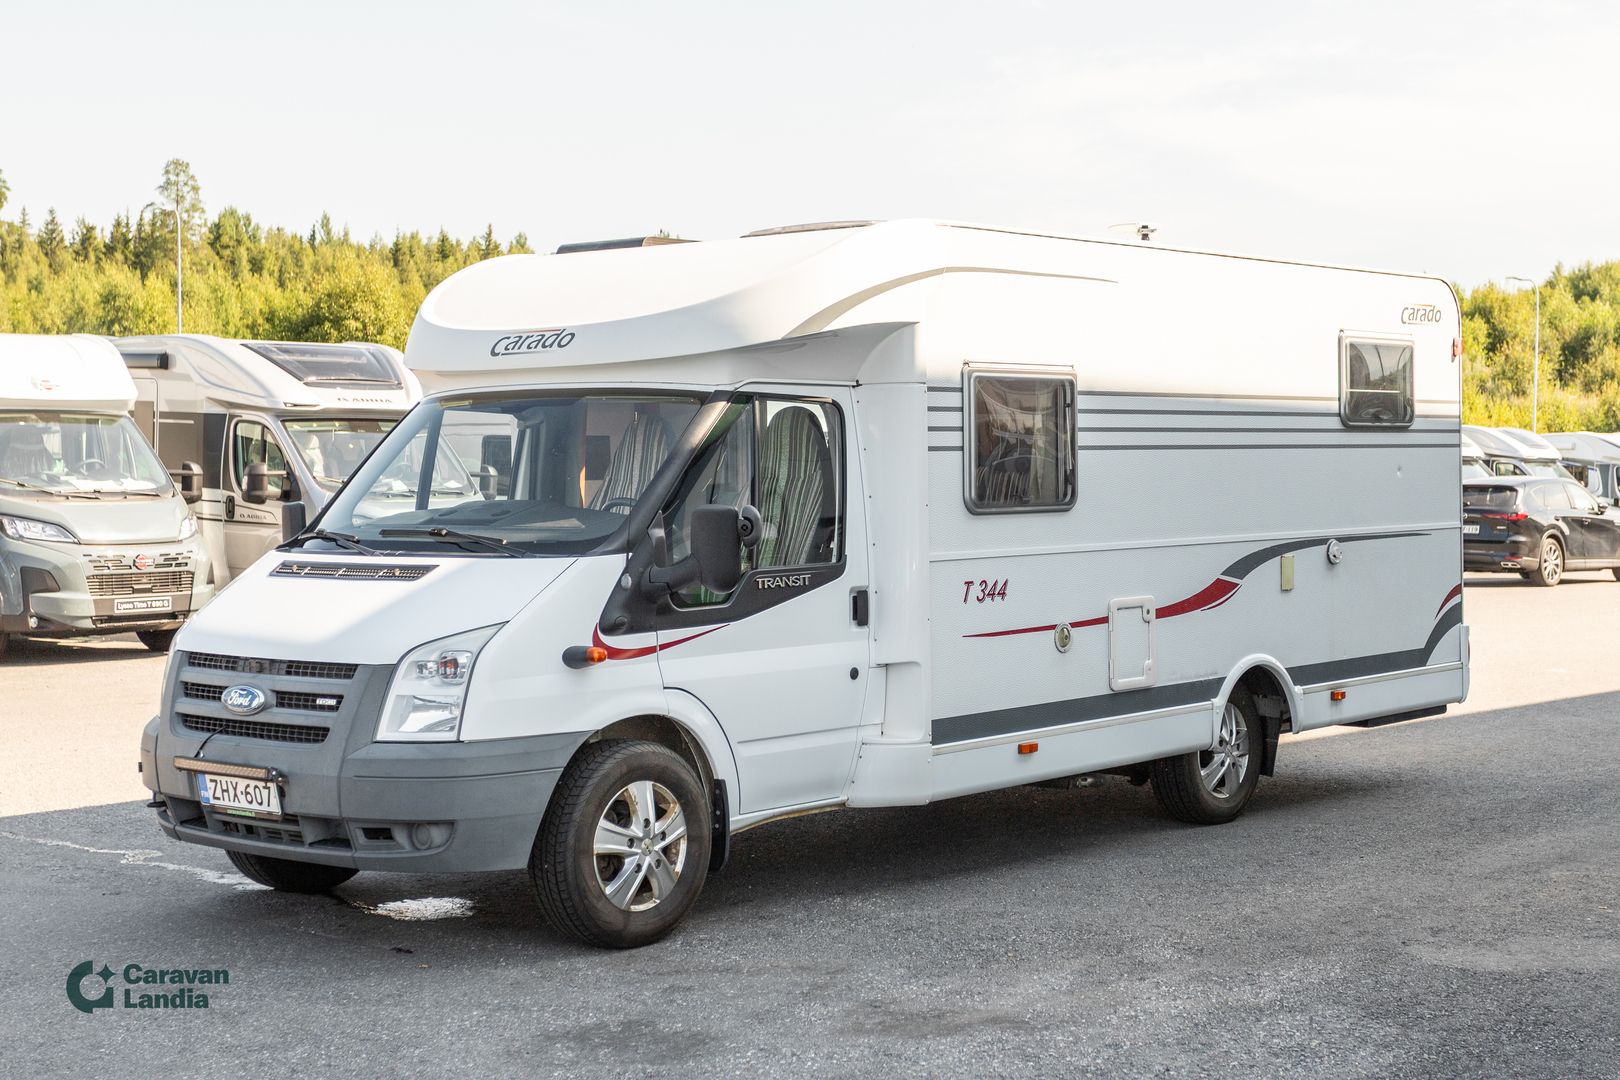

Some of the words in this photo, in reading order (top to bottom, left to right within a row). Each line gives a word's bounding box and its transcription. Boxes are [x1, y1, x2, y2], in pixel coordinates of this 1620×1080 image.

[756, 574, 812, 589] TRANSIT
[963, 580, 975, 604] T
[976, 578, 1009, 604] 344
[228, 689, 250, 705] Ford
[209, 779, 271, 807] ZHX-607
